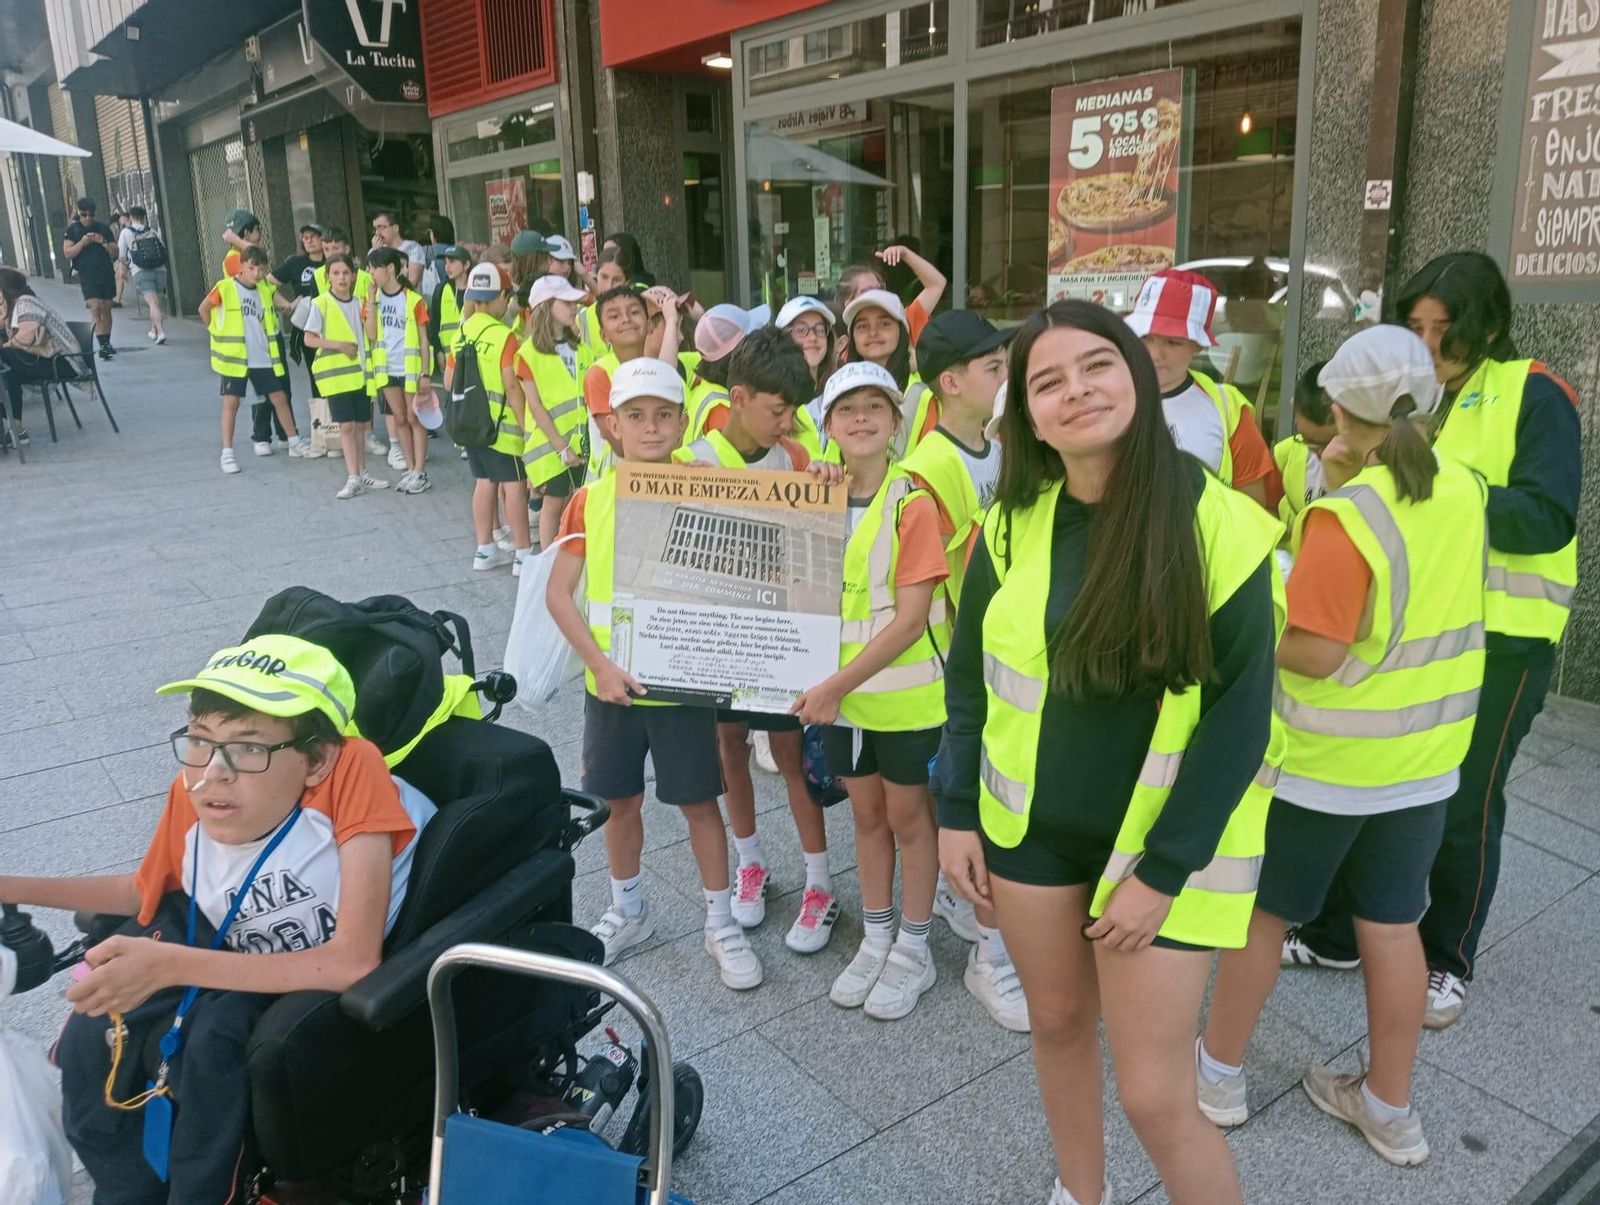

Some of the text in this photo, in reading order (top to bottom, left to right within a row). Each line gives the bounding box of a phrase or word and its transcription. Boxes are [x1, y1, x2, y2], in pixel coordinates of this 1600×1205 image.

[345, 49, 416, 69] La Tacita
[1075, 86, 1154, 113] MEDIANAS
[1109, 134, 1141, 150] LOCAL
[1515, 250, 1600, 277] DELICIOS
[630, 480, 641, 494] O
[645, 480, 683, 496] MAR
[689, 483, 760, 501] EMPEZA
[756, 589, 777, 606] ICI
